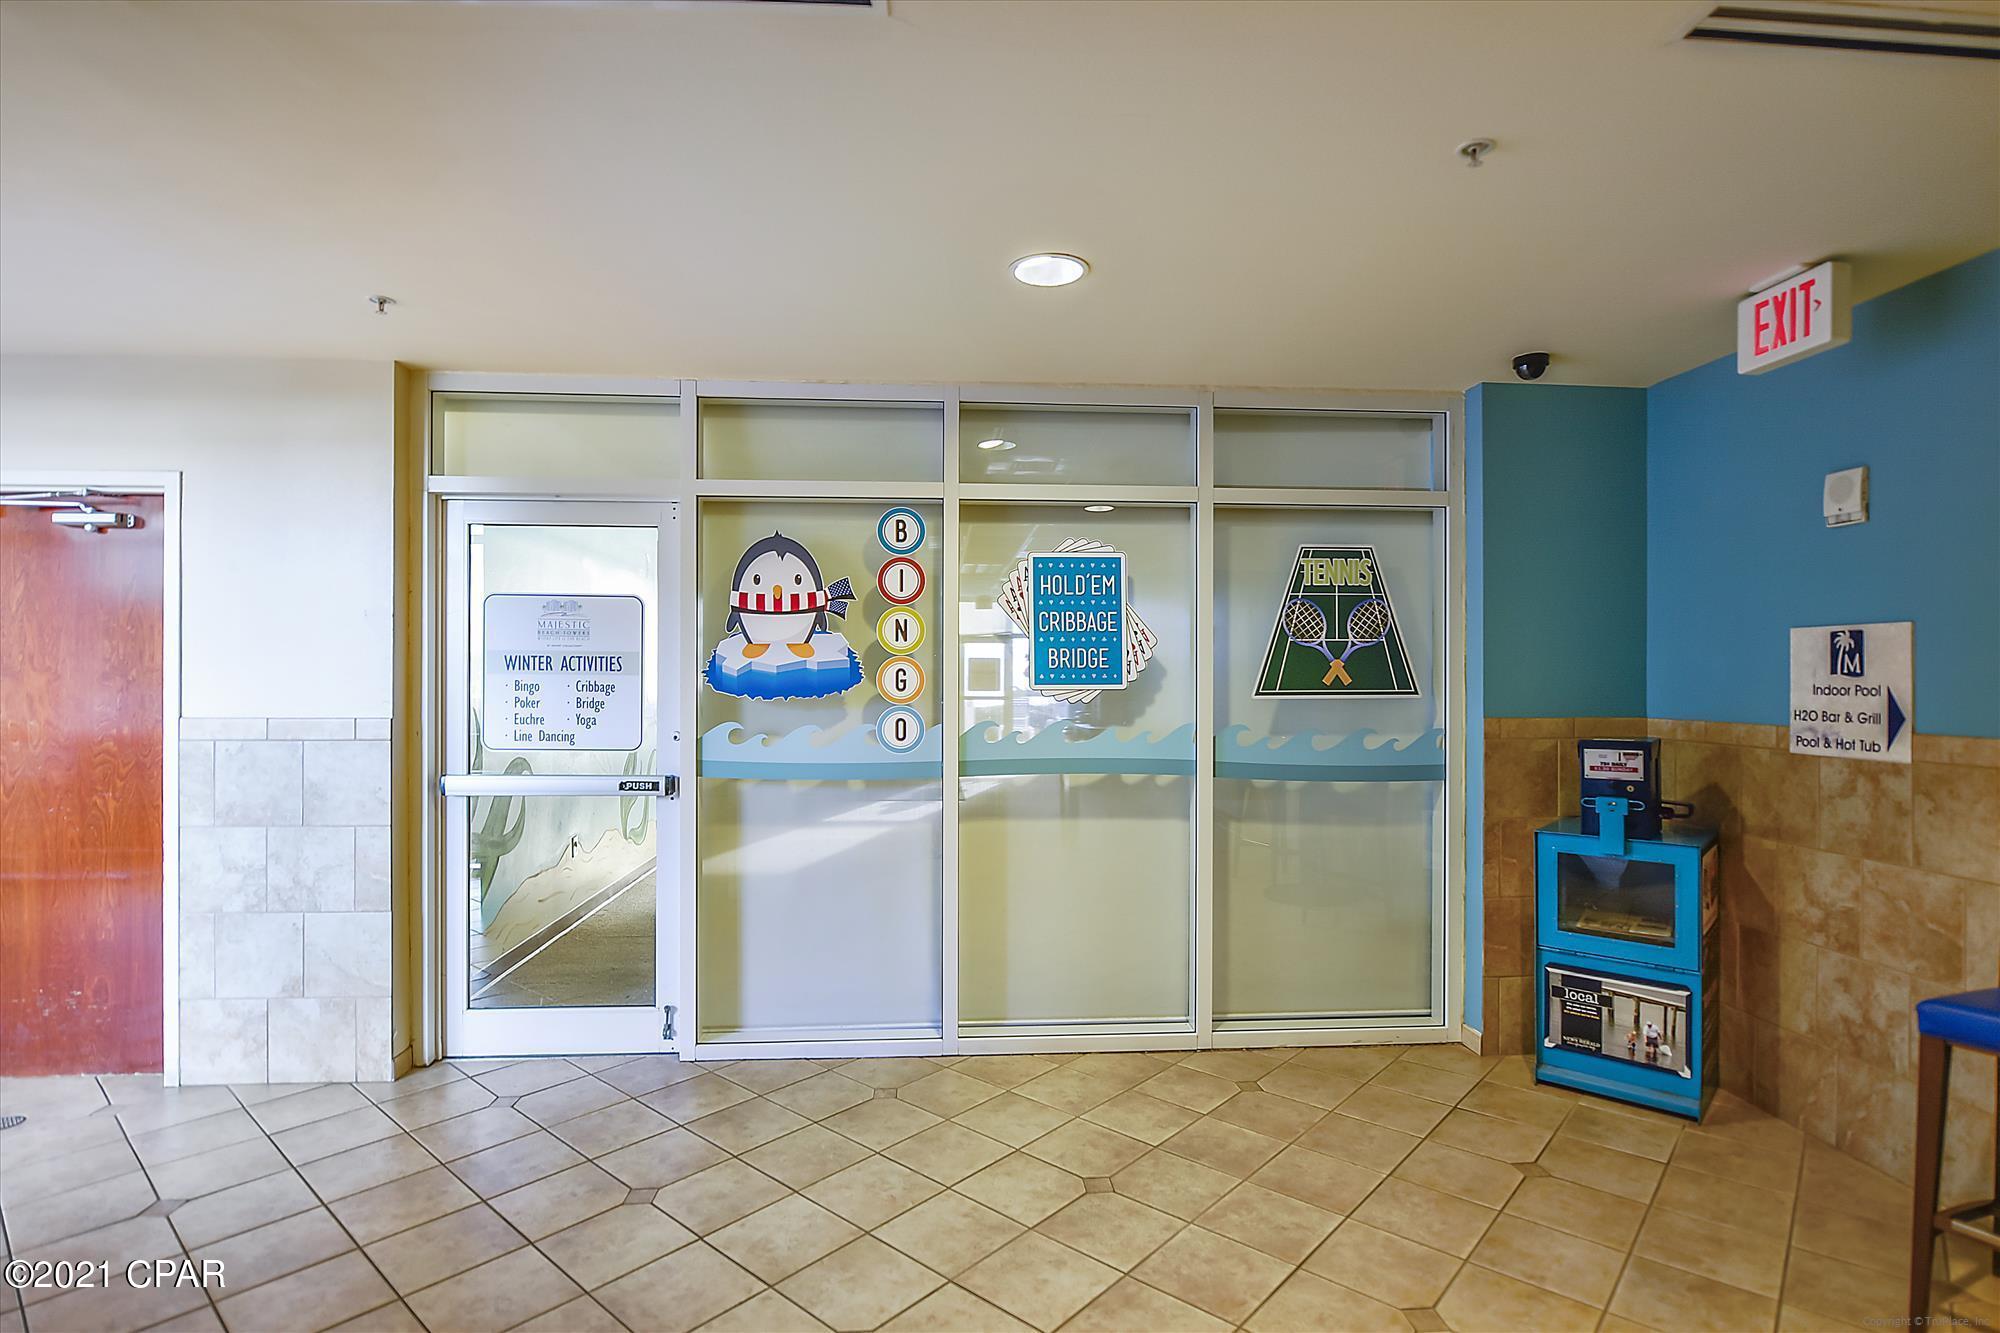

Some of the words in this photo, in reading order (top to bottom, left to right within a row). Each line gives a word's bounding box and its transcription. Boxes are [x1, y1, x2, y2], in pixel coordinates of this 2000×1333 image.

[1754, 278, 1816, 356] EXIT
[1301, 558, 1372, 586] TENNIS
[1040, 573, 1115, 595] HOLD'EM
[538, 620, 590, 629] MAJESTIC
[1038, 611, 1118, 632] CRIBBAGE
[504, 655, 553, 671] WINTER
[560, 655, 623, 672] ACTIVITIES
[1048, 648, 1109, 669] BRIDGE
[1843, 652, 1861, 673] M
[514, 680, 540, 695] Bingo
[576, 680, 616, 696] Cribbage
[1813, 684, 1851, 696] Indoor
[1855, 684, 1881, 697] Pool
[514, 697, 541, 708] Poker
[576, 697, 605, 713] Bridge
[514, 713, 545, 725] Euchre
[576, 713, 597, 729] Yoga
[1794, 710, 1818, 722] H2O
[1822, 711, 1840, 723] Bar
[1844, 711, 1854, 724] &
[1857, 711, 1881, 725] Grill
[514, 730, 533, 742] Line
[538, 730, 575, 746] Dancing
[1796, 735, 1820, 748] Pool
[1823, 737, 1832, 749] &
[1836, 738, 1856, 751] Hot
[1860, 740, 1881, 753] Tub
[624, 782, 653, 790] PUSH
[1563, 987, 1600, 1005] local
